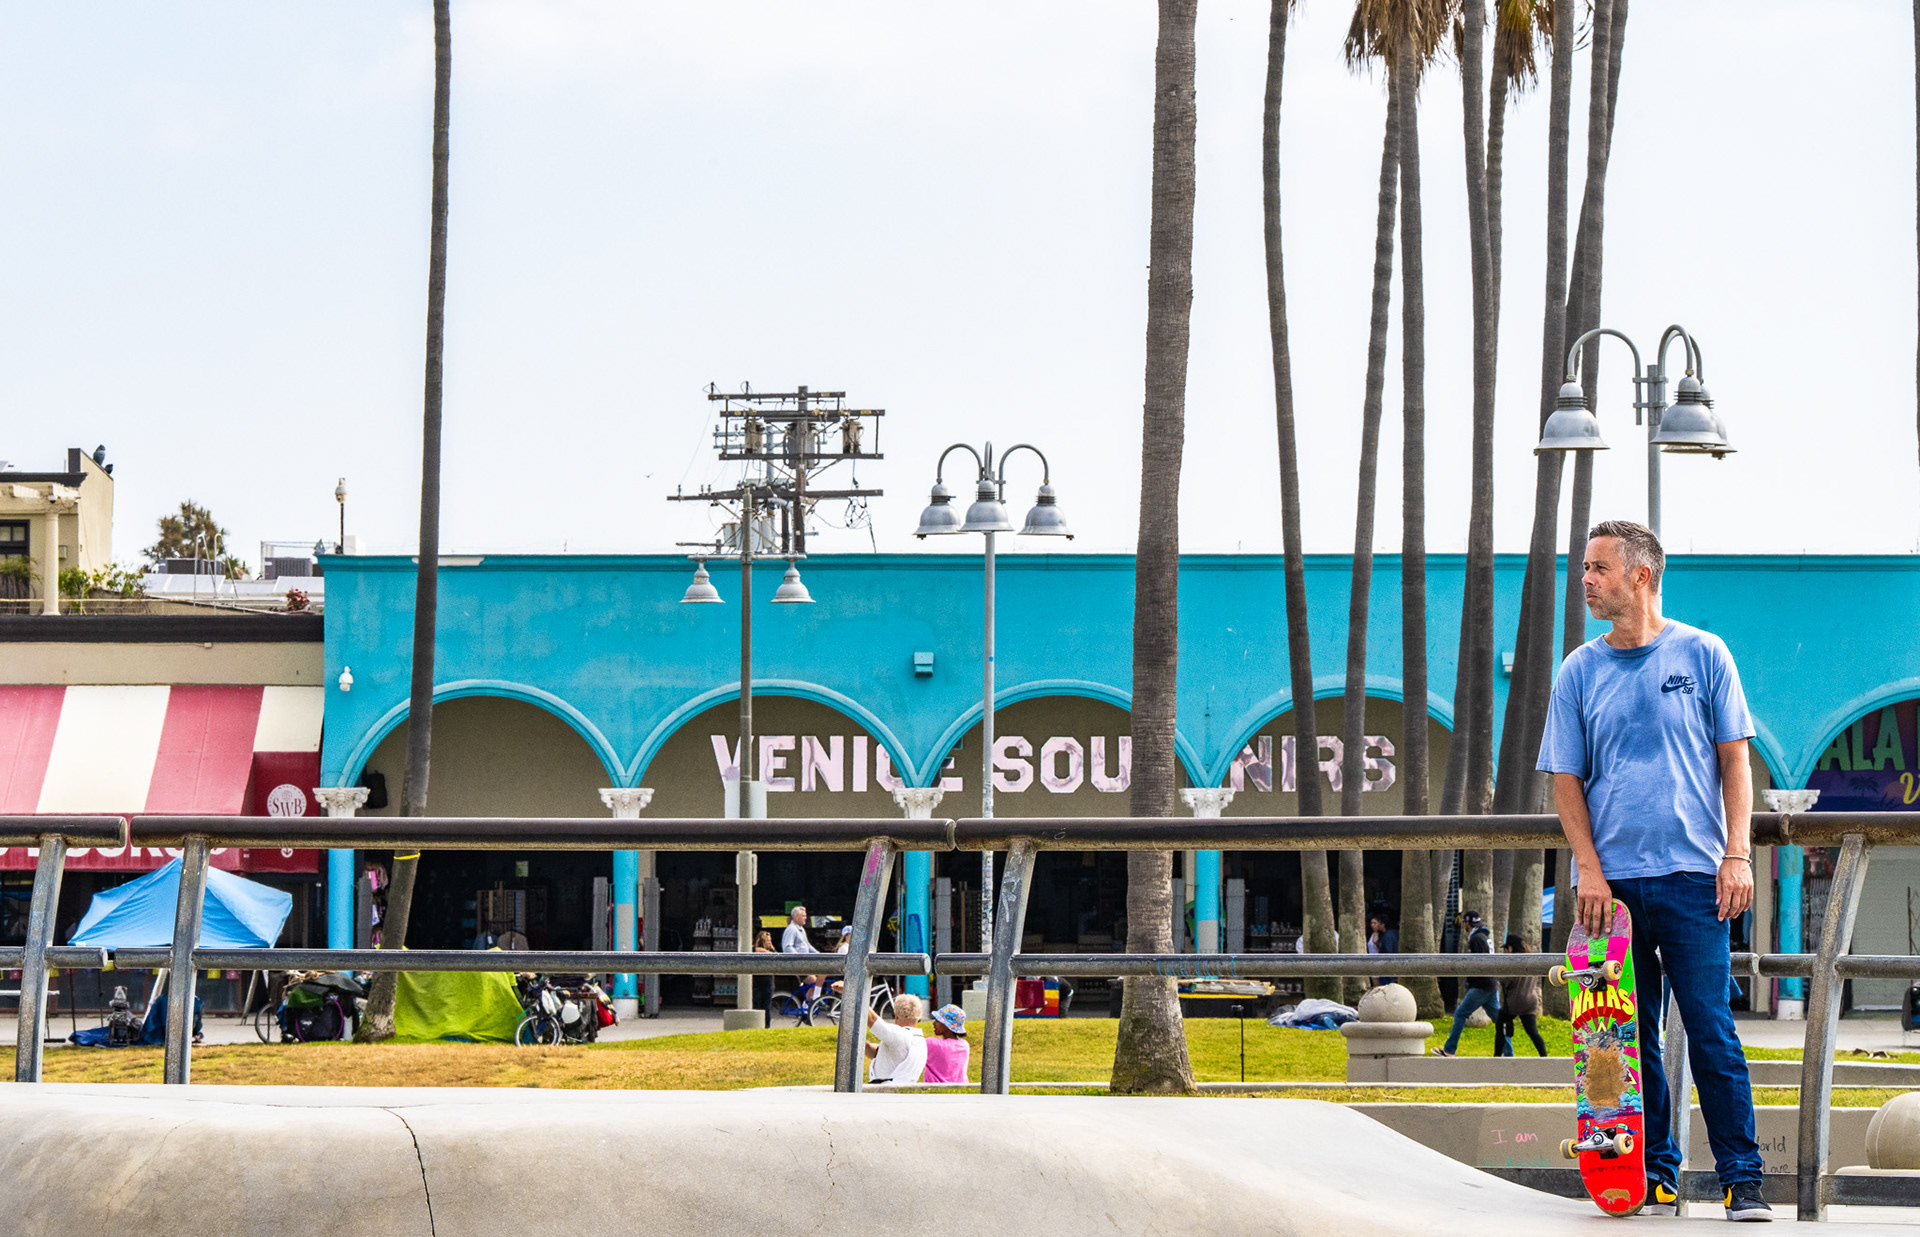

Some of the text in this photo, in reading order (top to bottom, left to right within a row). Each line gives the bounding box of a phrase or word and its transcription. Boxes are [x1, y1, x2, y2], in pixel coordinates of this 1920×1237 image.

[1666, 674, 1690, 685] NIKE
[1681, 686, 1694, 695] SB
[991, 735, 1396, 793] SOUNIRS
[272, 798, 303, 817] SWB
[1490, 1129, 1538, 1145] I am
[1756, 1136, 1787, 1154] orld
